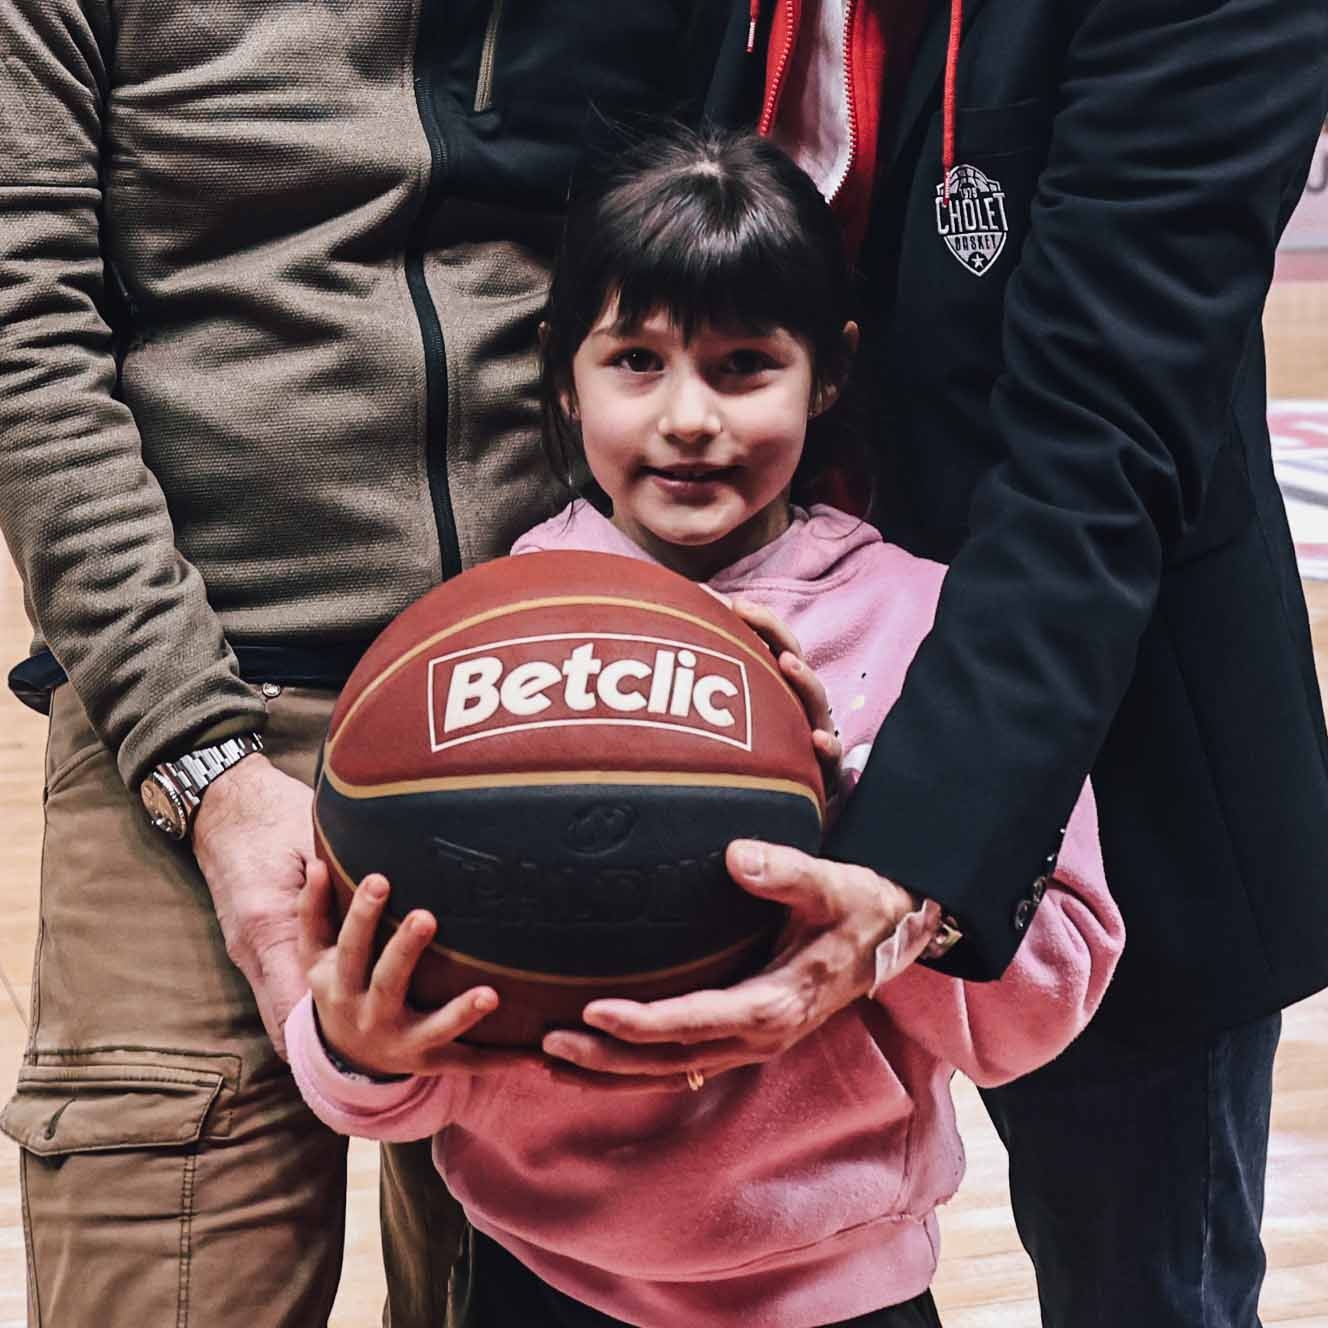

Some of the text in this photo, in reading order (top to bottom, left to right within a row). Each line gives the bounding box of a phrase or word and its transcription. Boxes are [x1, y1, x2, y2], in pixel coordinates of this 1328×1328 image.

[935, 193, 1009, 235] CHOLET
[955, 234, 998, 251] BASKET
[443, 642, 739, 734] Betclic
